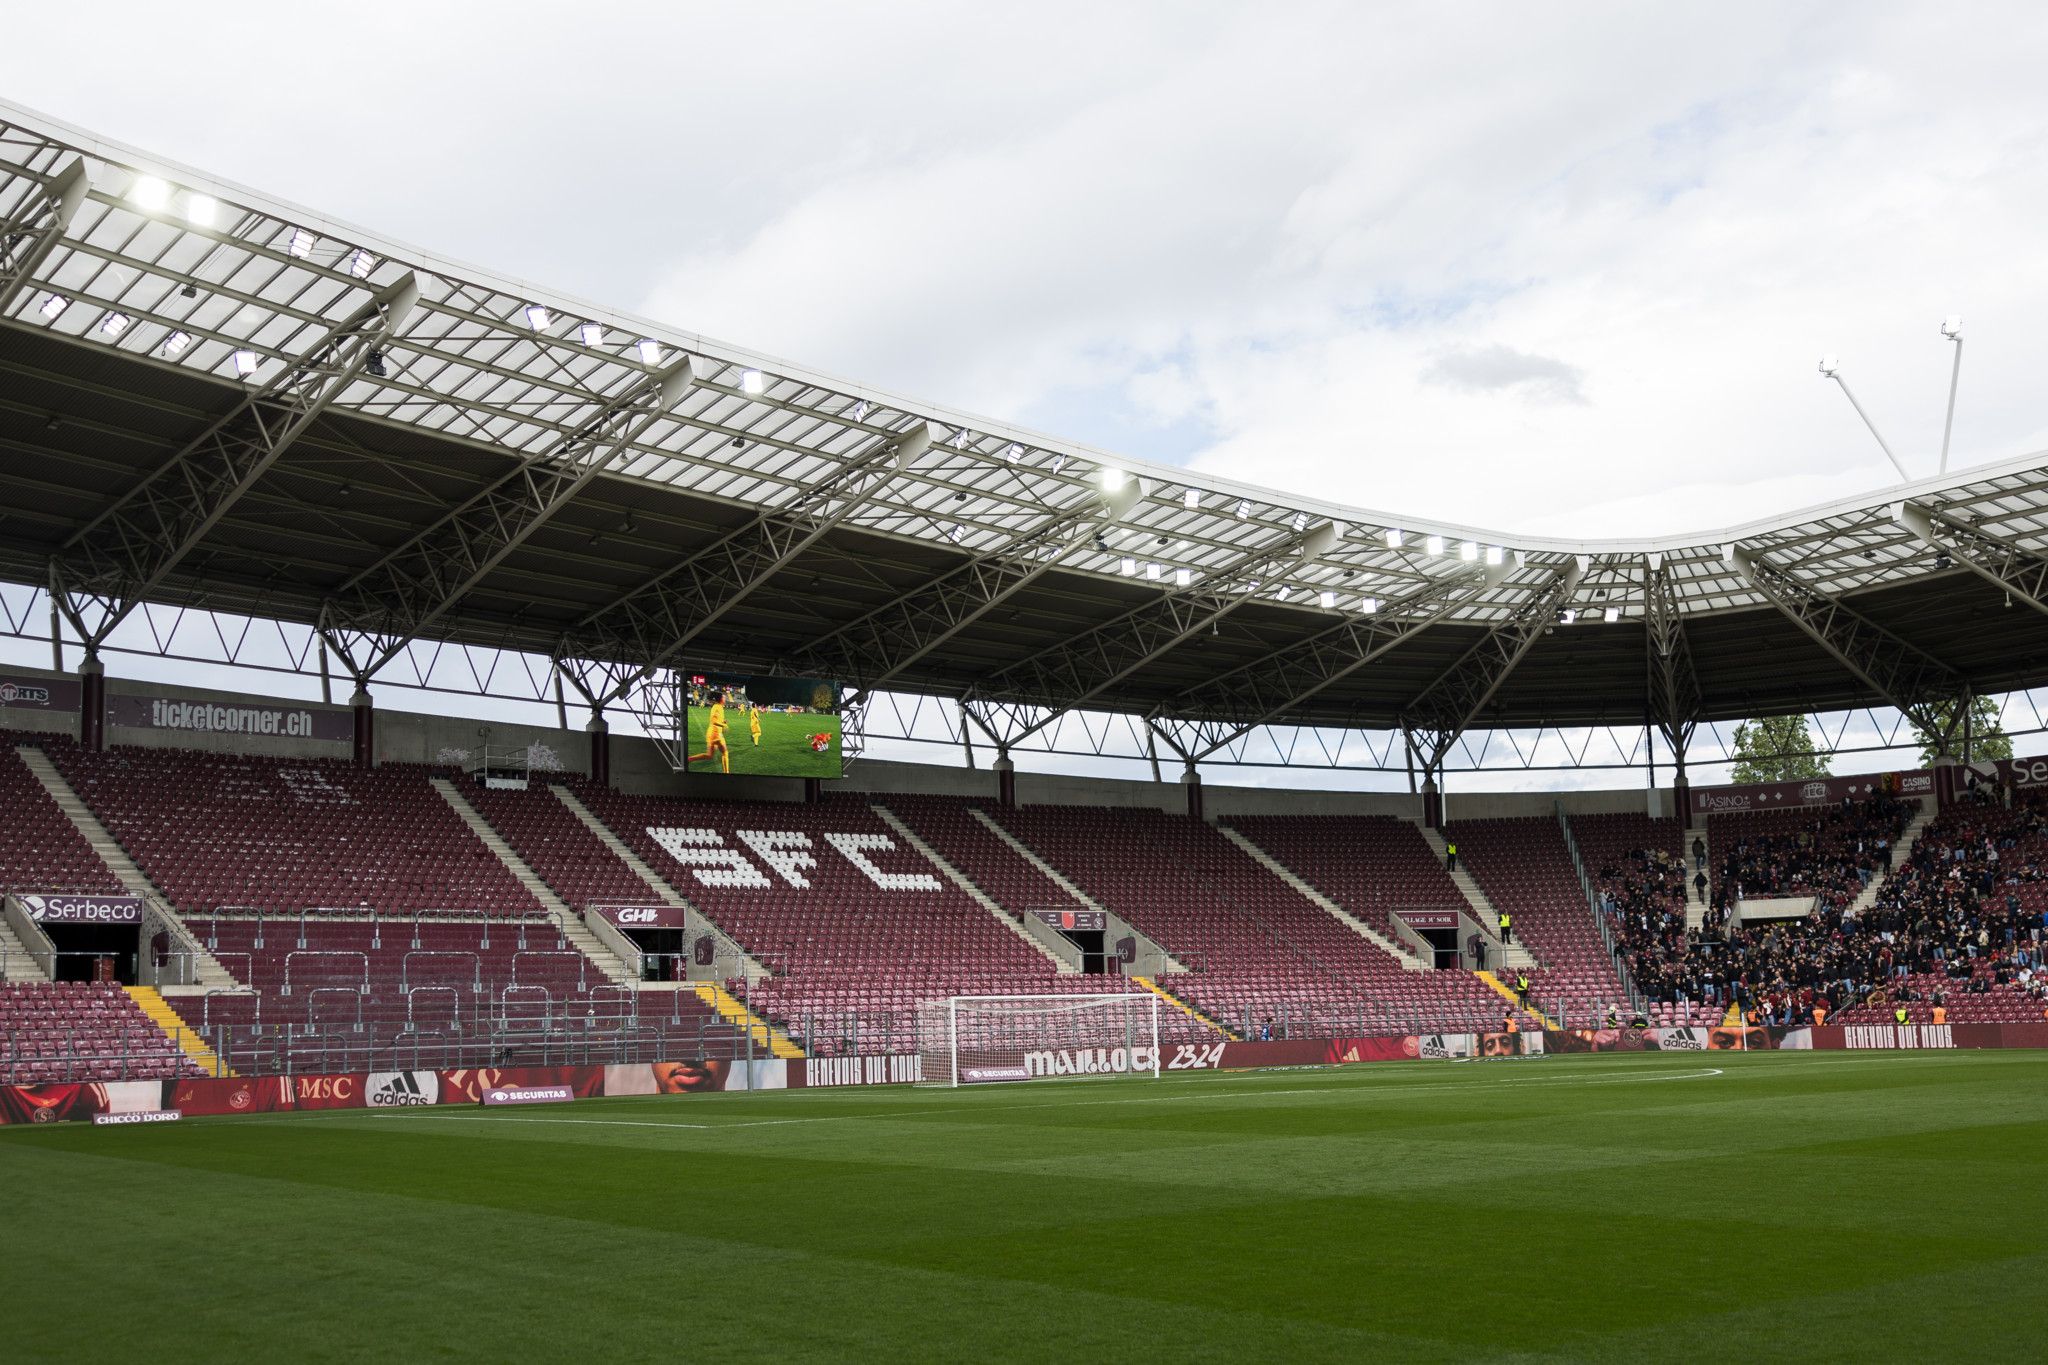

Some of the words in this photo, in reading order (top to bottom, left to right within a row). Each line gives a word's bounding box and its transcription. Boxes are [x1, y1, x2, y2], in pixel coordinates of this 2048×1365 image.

[152, 699, 312, 736] ticketcorner.ch
[2011, 759, 2048, 783] Se
[1902, 776, 1931, 787] CASINO
[48, 899, 136, 919] Serbeco
[1663, 1039, 1702, 1050] adidas
[1844, 1025, 1895, 1049] GENEVOIS
[1897, 1025, 1919, 1049] QUE
[1920, 1025, 1957, 1048] NOUS.
[1168, 1042, 1226, 1069] 2324
[1422, 1046, 1450, 1058] adidas
[806, 1055, 862, 1087] GENEVOIS
[866, 1056, 888, 1085] QUE
[982, 1069, 1026, 1078] SECURITAS
[300, 1077, 352, 1099] MSC
[509, 1090, 567, 1100] SECURITAS
[373, 1091, 428, 1106] adidas
[96, 1114, 141, 1125] CHICCO
[144, 1112, 179, 1122] D'ORO
